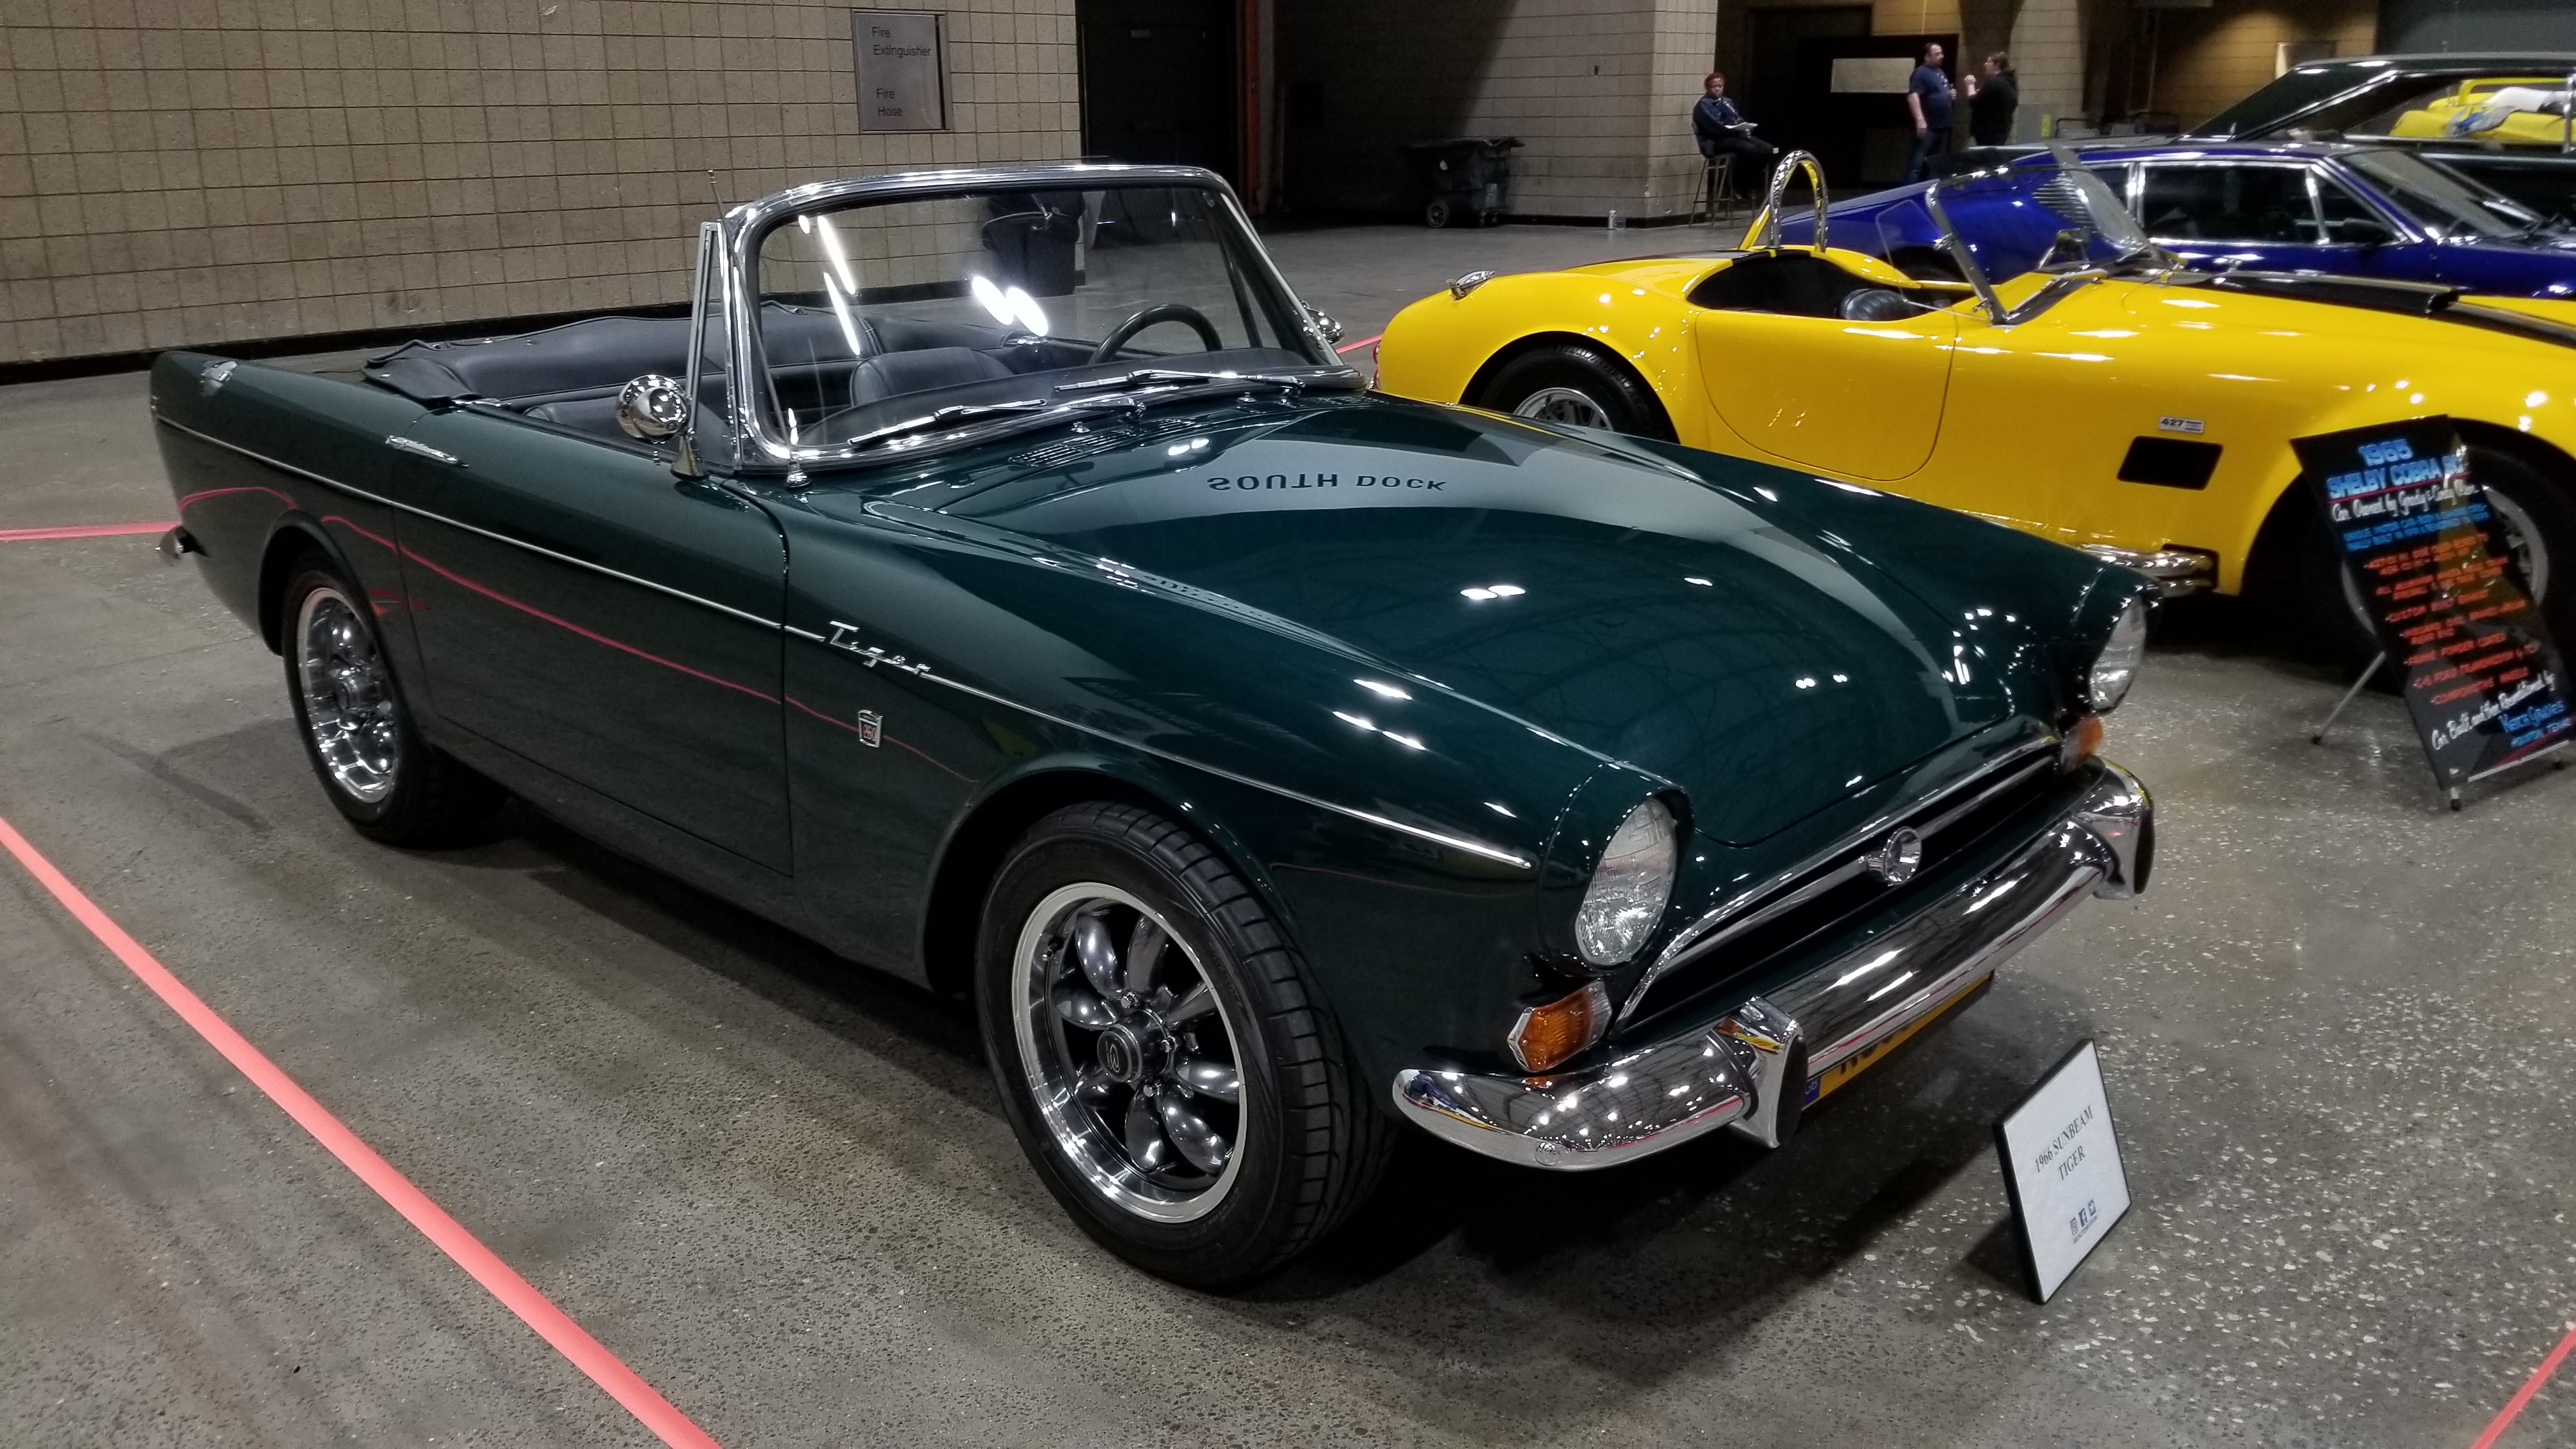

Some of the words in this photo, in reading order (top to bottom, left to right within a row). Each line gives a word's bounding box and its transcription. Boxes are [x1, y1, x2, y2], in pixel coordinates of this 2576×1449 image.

[871, 26, 891, 37] Fire
[873, 45, 931, 58] Extinguisher
[876, 88, 895, 98] Fire
[878, 106, 903, 116] Hose
[2358, 438, 2414, 467] 1965
[2327, 467, 2386, 499] SHELBY
[2389, 457, 2443, 486] COBRA
[830, 620, 931, 675] Tiger
[2035, 1147, 2053, 1173] 1966
[2053, 1105, 2093, 1156] SUNBEAM
[2059, 1146, 2086, 1181] TIGER
